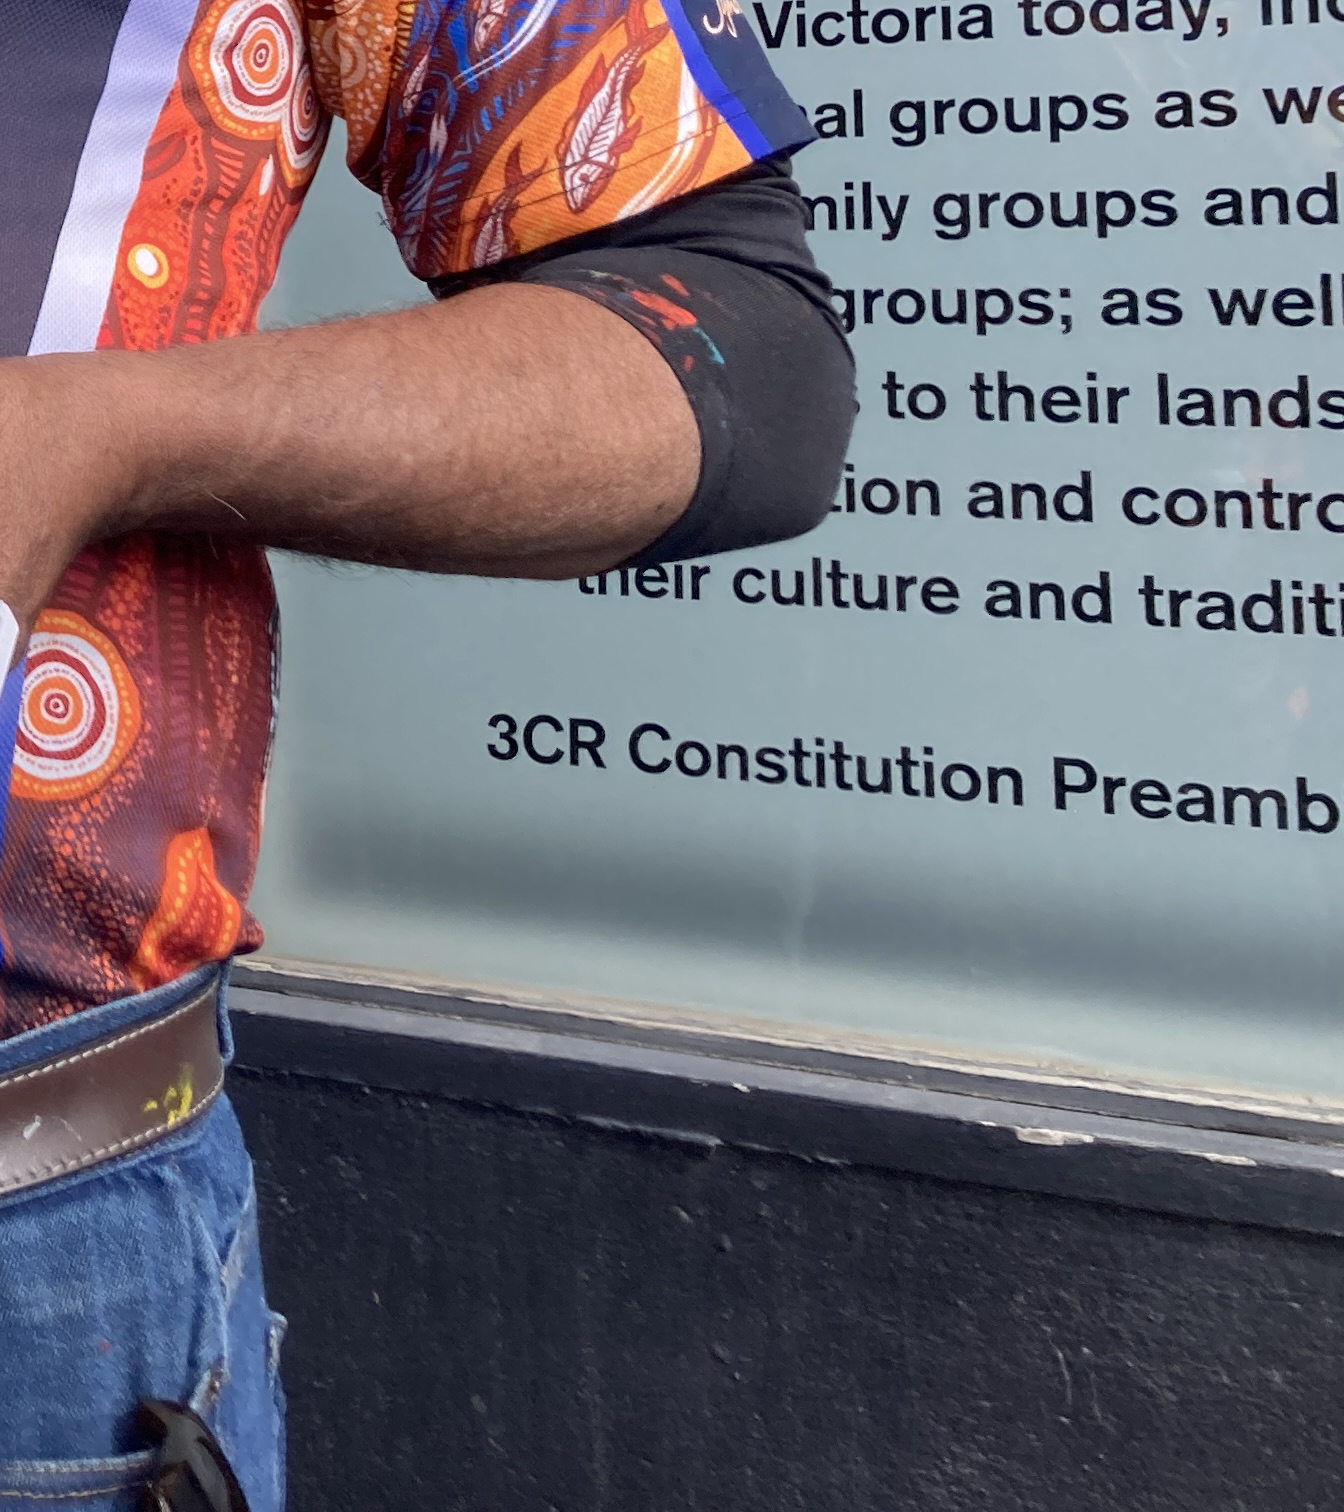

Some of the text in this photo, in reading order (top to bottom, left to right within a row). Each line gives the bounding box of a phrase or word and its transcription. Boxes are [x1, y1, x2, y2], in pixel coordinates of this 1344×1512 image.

[796, 89, 864, 139] al
[890, 93, 1129, 147] groups
[1155, 89, 1237, 128] as
[933, 189, 1178, 240] groups
[1204, 172, 1339, 226] and
[834, 273, 1344, 336] groups; as wel
[882, 371, 946, 420] to
[970, 371, 1130, 424] their
[830, 464, 941, 516] ion
[967, 471, 1093, 522] and
[733, 557, 959, 614] culture
[984, 571, 1112, 624] and
[488, 714, 1340, 834] 3CR Constitution Preamb
